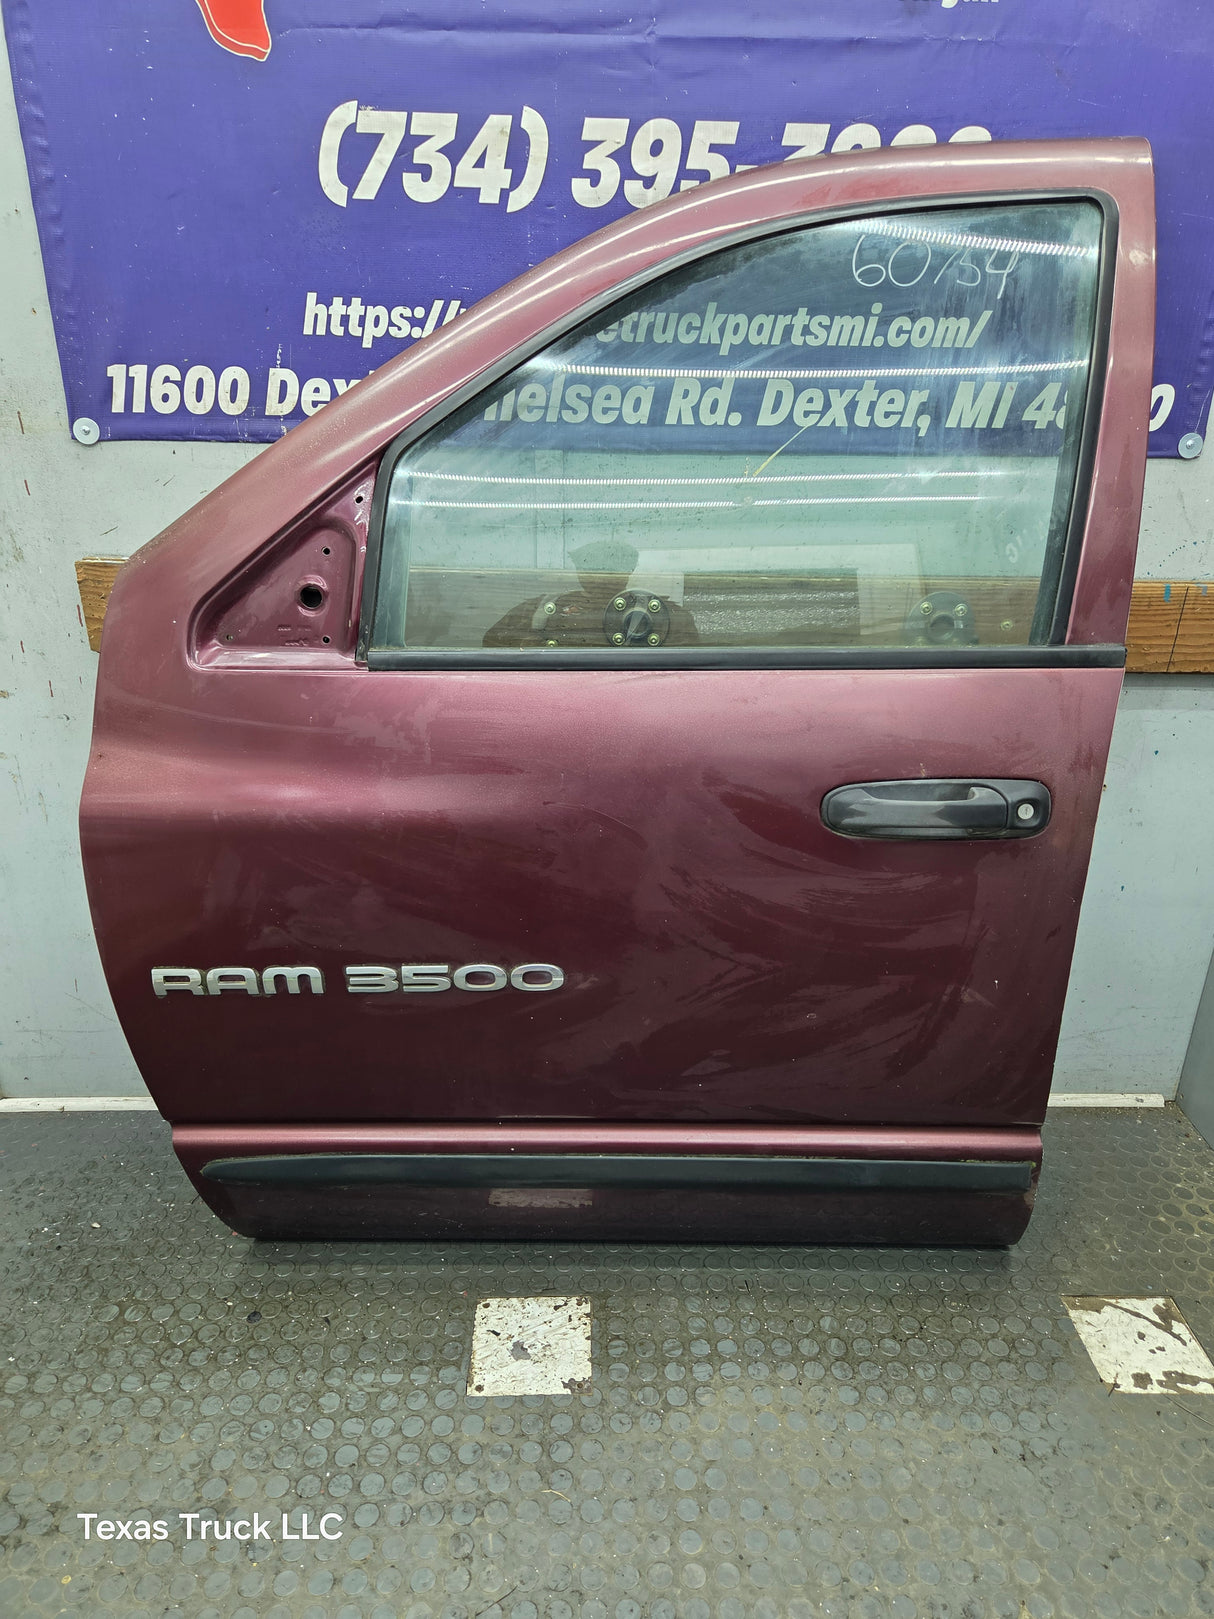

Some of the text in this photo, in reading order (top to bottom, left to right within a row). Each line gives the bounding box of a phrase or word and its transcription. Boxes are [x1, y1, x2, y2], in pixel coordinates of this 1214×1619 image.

[318, 100, 549, 213] (734)
[107, 364, 250, 416] 11600
[483, 372, 655, 425] elsea
[665, 376, 742, 426] Rd.
[757, 378, 930, 437] Dexter,
[945, 382, 1018, 430] MI
[151, 963, 566, 998] RAM 3500
